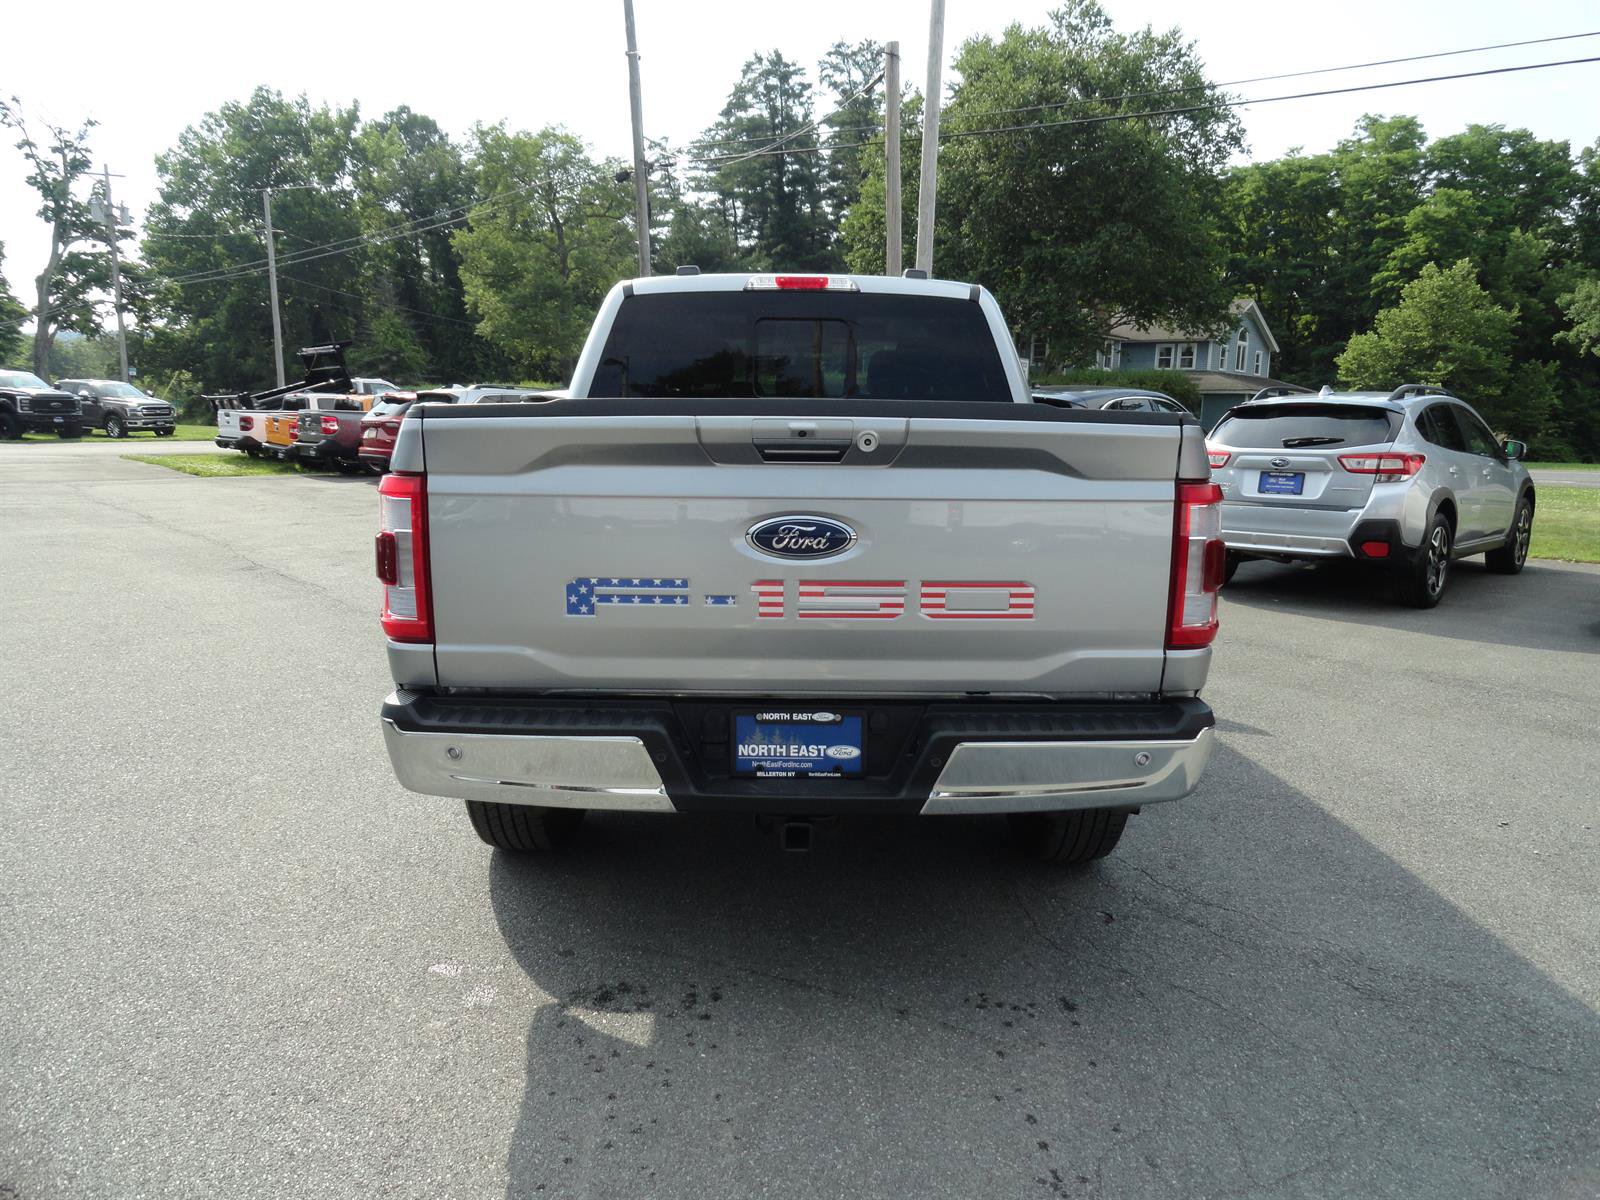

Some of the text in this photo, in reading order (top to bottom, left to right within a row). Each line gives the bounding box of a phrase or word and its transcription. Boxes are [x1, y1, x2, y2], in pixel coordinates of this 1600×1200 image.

[772, 524, 830, 550] Ford
[566, 577, 1036, 619] F-150
[762, 712, 790, 721] NORTH
[792, 712, 813, 721] EAST
[738, 744, 787, 757] NORTH
[790, 744, 827, 757] EAST
